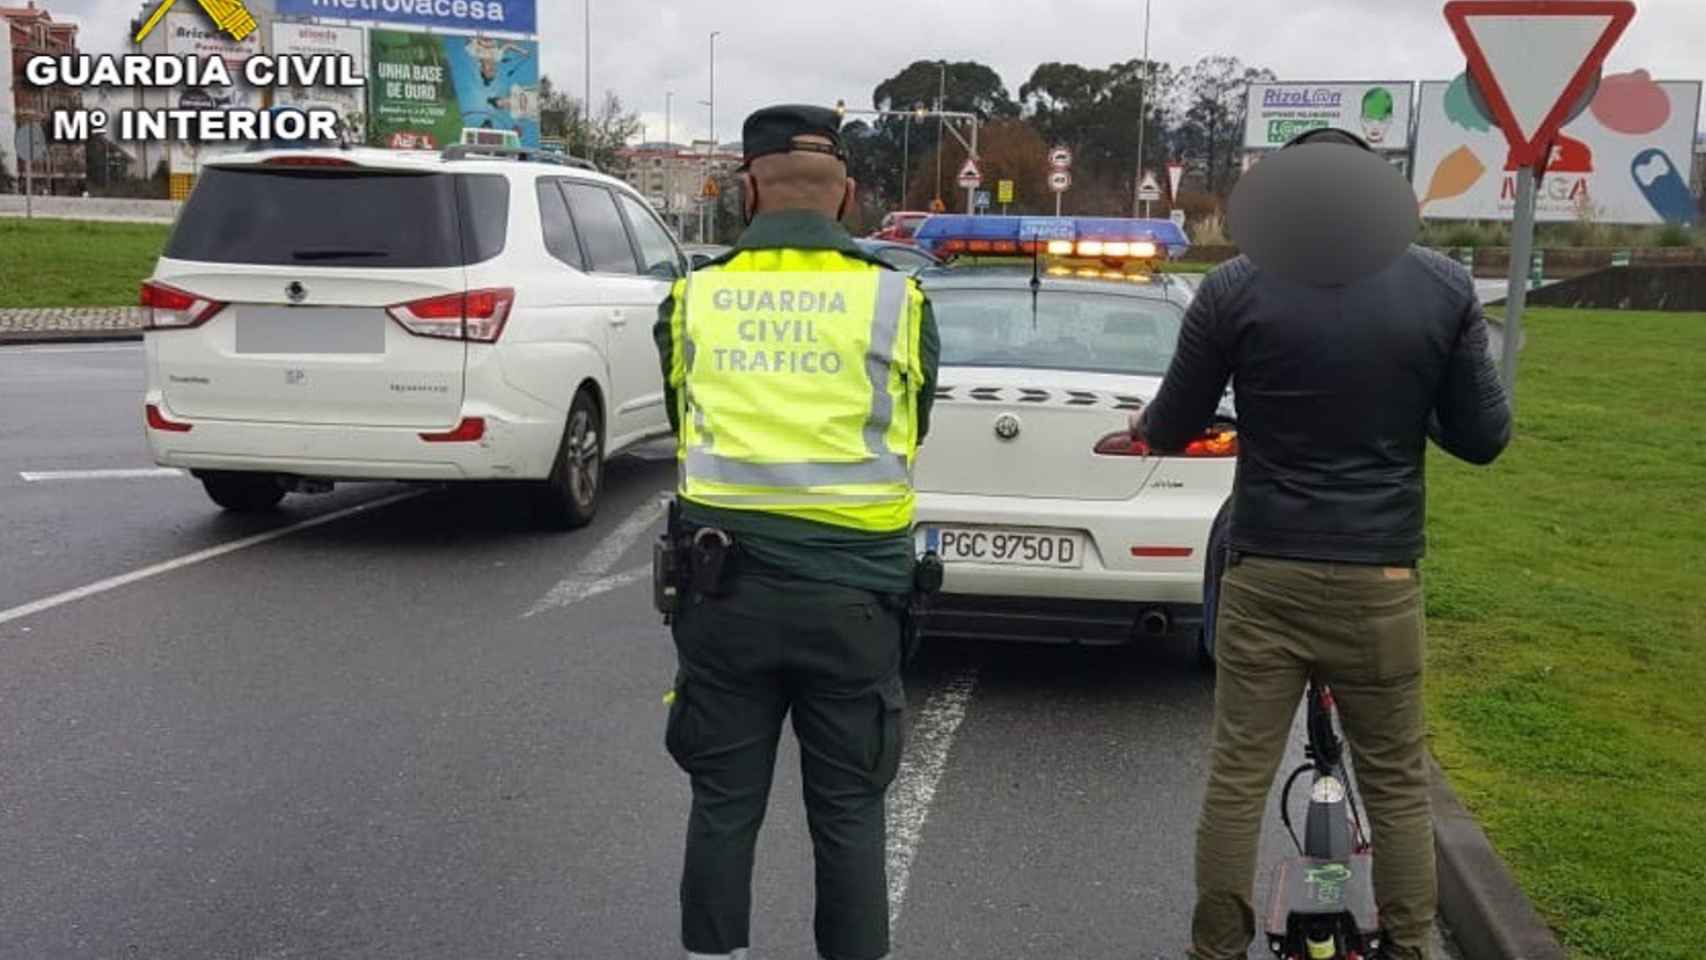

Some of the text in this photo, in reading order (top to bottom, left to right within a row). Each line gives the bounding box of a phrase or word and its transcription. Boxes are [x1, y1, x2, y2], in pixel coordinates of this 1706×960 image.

[310, 0, 505, 21] metrovacesa
[378, 62, 443, 82] UNHA BASE
[387, 82, 436, 100] DE OURO
[1501, 176, 1591, 200] MGA
[712, 287, 847, 314] GUARDIA
[738, 319, 818, 343] CIVIL
[713, 348, 842, 375] TRAFICO
[941, 531, 1075, 564] PGC 9750 D
